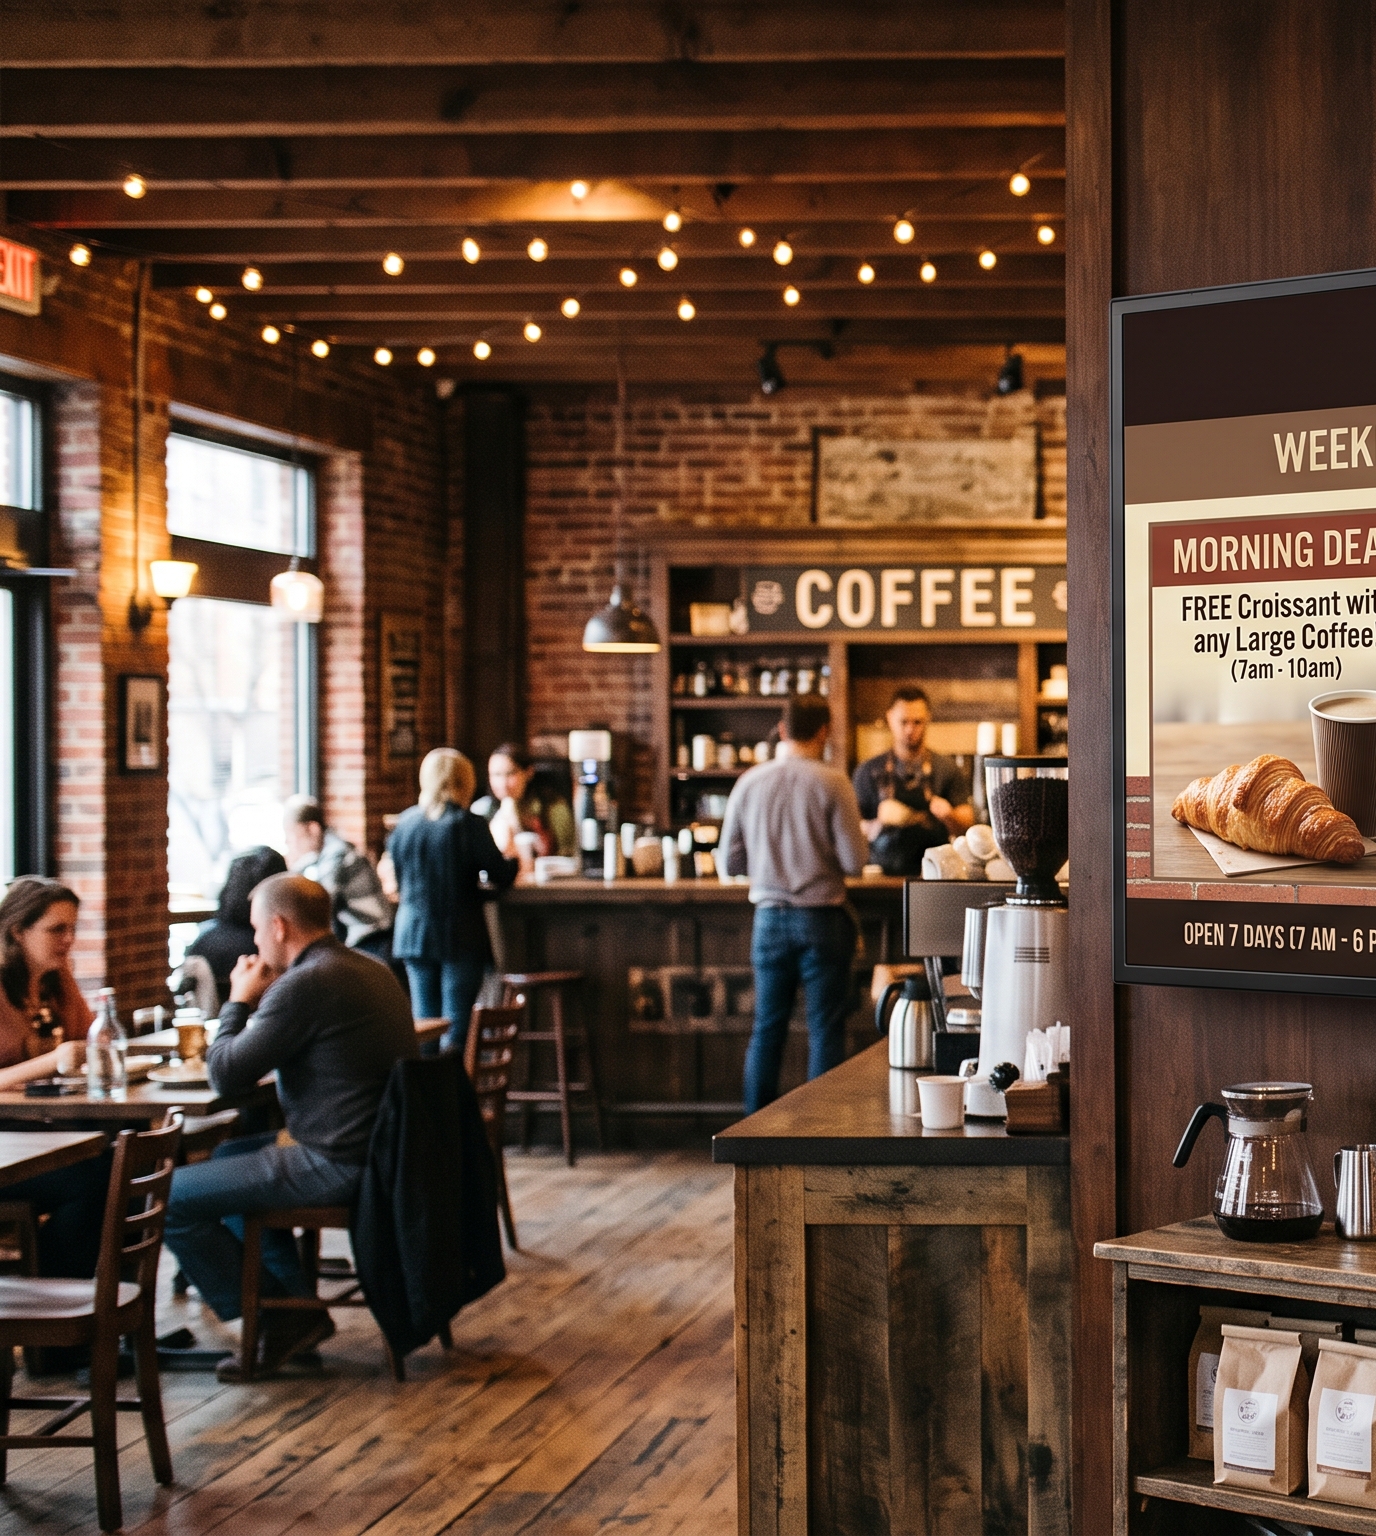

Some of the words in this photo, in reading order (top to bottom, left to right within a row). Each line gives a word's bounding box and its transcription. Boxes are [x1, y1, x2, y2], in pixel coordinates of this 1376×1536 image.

[0, 240, 37, 302] XIT
[1173, 531, 1314, 574] MORNING
[795, 568, 1037, 628] COFFEE
[1182, 594, 1233, 622] FREE
[1238, 590, 1341, 620] Croissant
[1193, 632, 1231, 659] any
[1236, 626, 1296, 657] Large
[1231, 659, 1274, 683] (7am
[1287, 655, 1342, 681] 10am)
[1184, 921, 1224, 946] OPEN
[1228, 923, 1239, 947] 7
[1243, 924, 1285, 949] DAYS
[1289, 925, 1306, 950] (7
[1310, 927, 1336, 952] AM
[1353, 928, 1364, 953] 6
